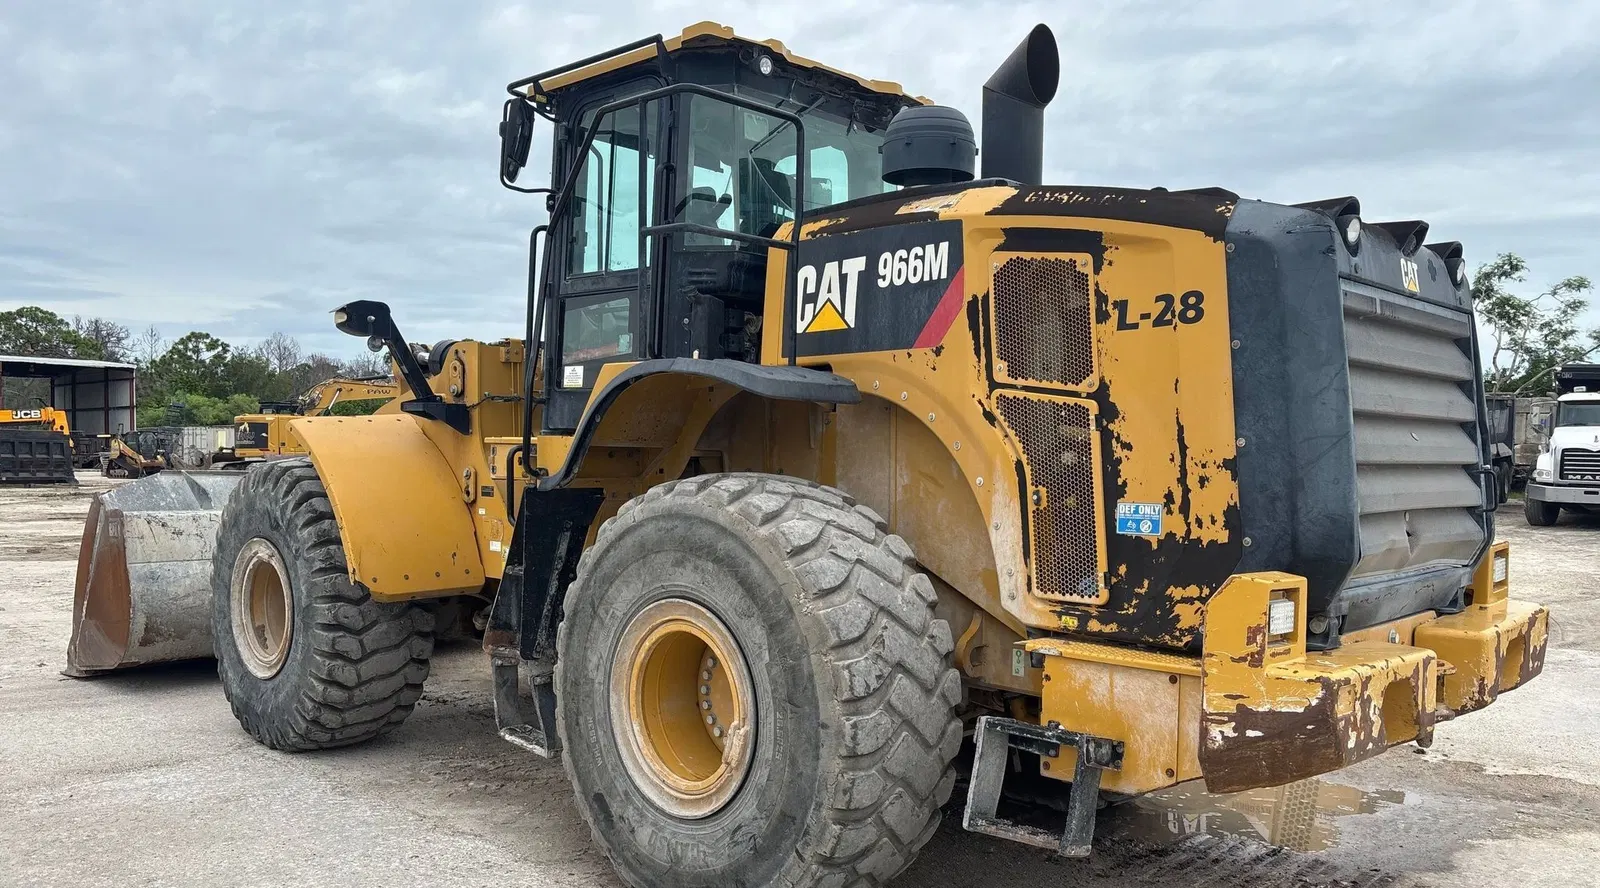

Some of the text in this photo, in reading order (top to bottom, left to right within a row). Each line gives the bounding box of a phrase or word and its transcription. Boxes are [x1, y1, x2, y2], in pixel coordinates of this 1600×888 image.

[1400, 258, 1420, 293] CAT
[796, 241, 949, 334] CAT 966M
[12, 410, 41, 419] JCB
[1119, 504, 1160, 515] DEF ONLY
